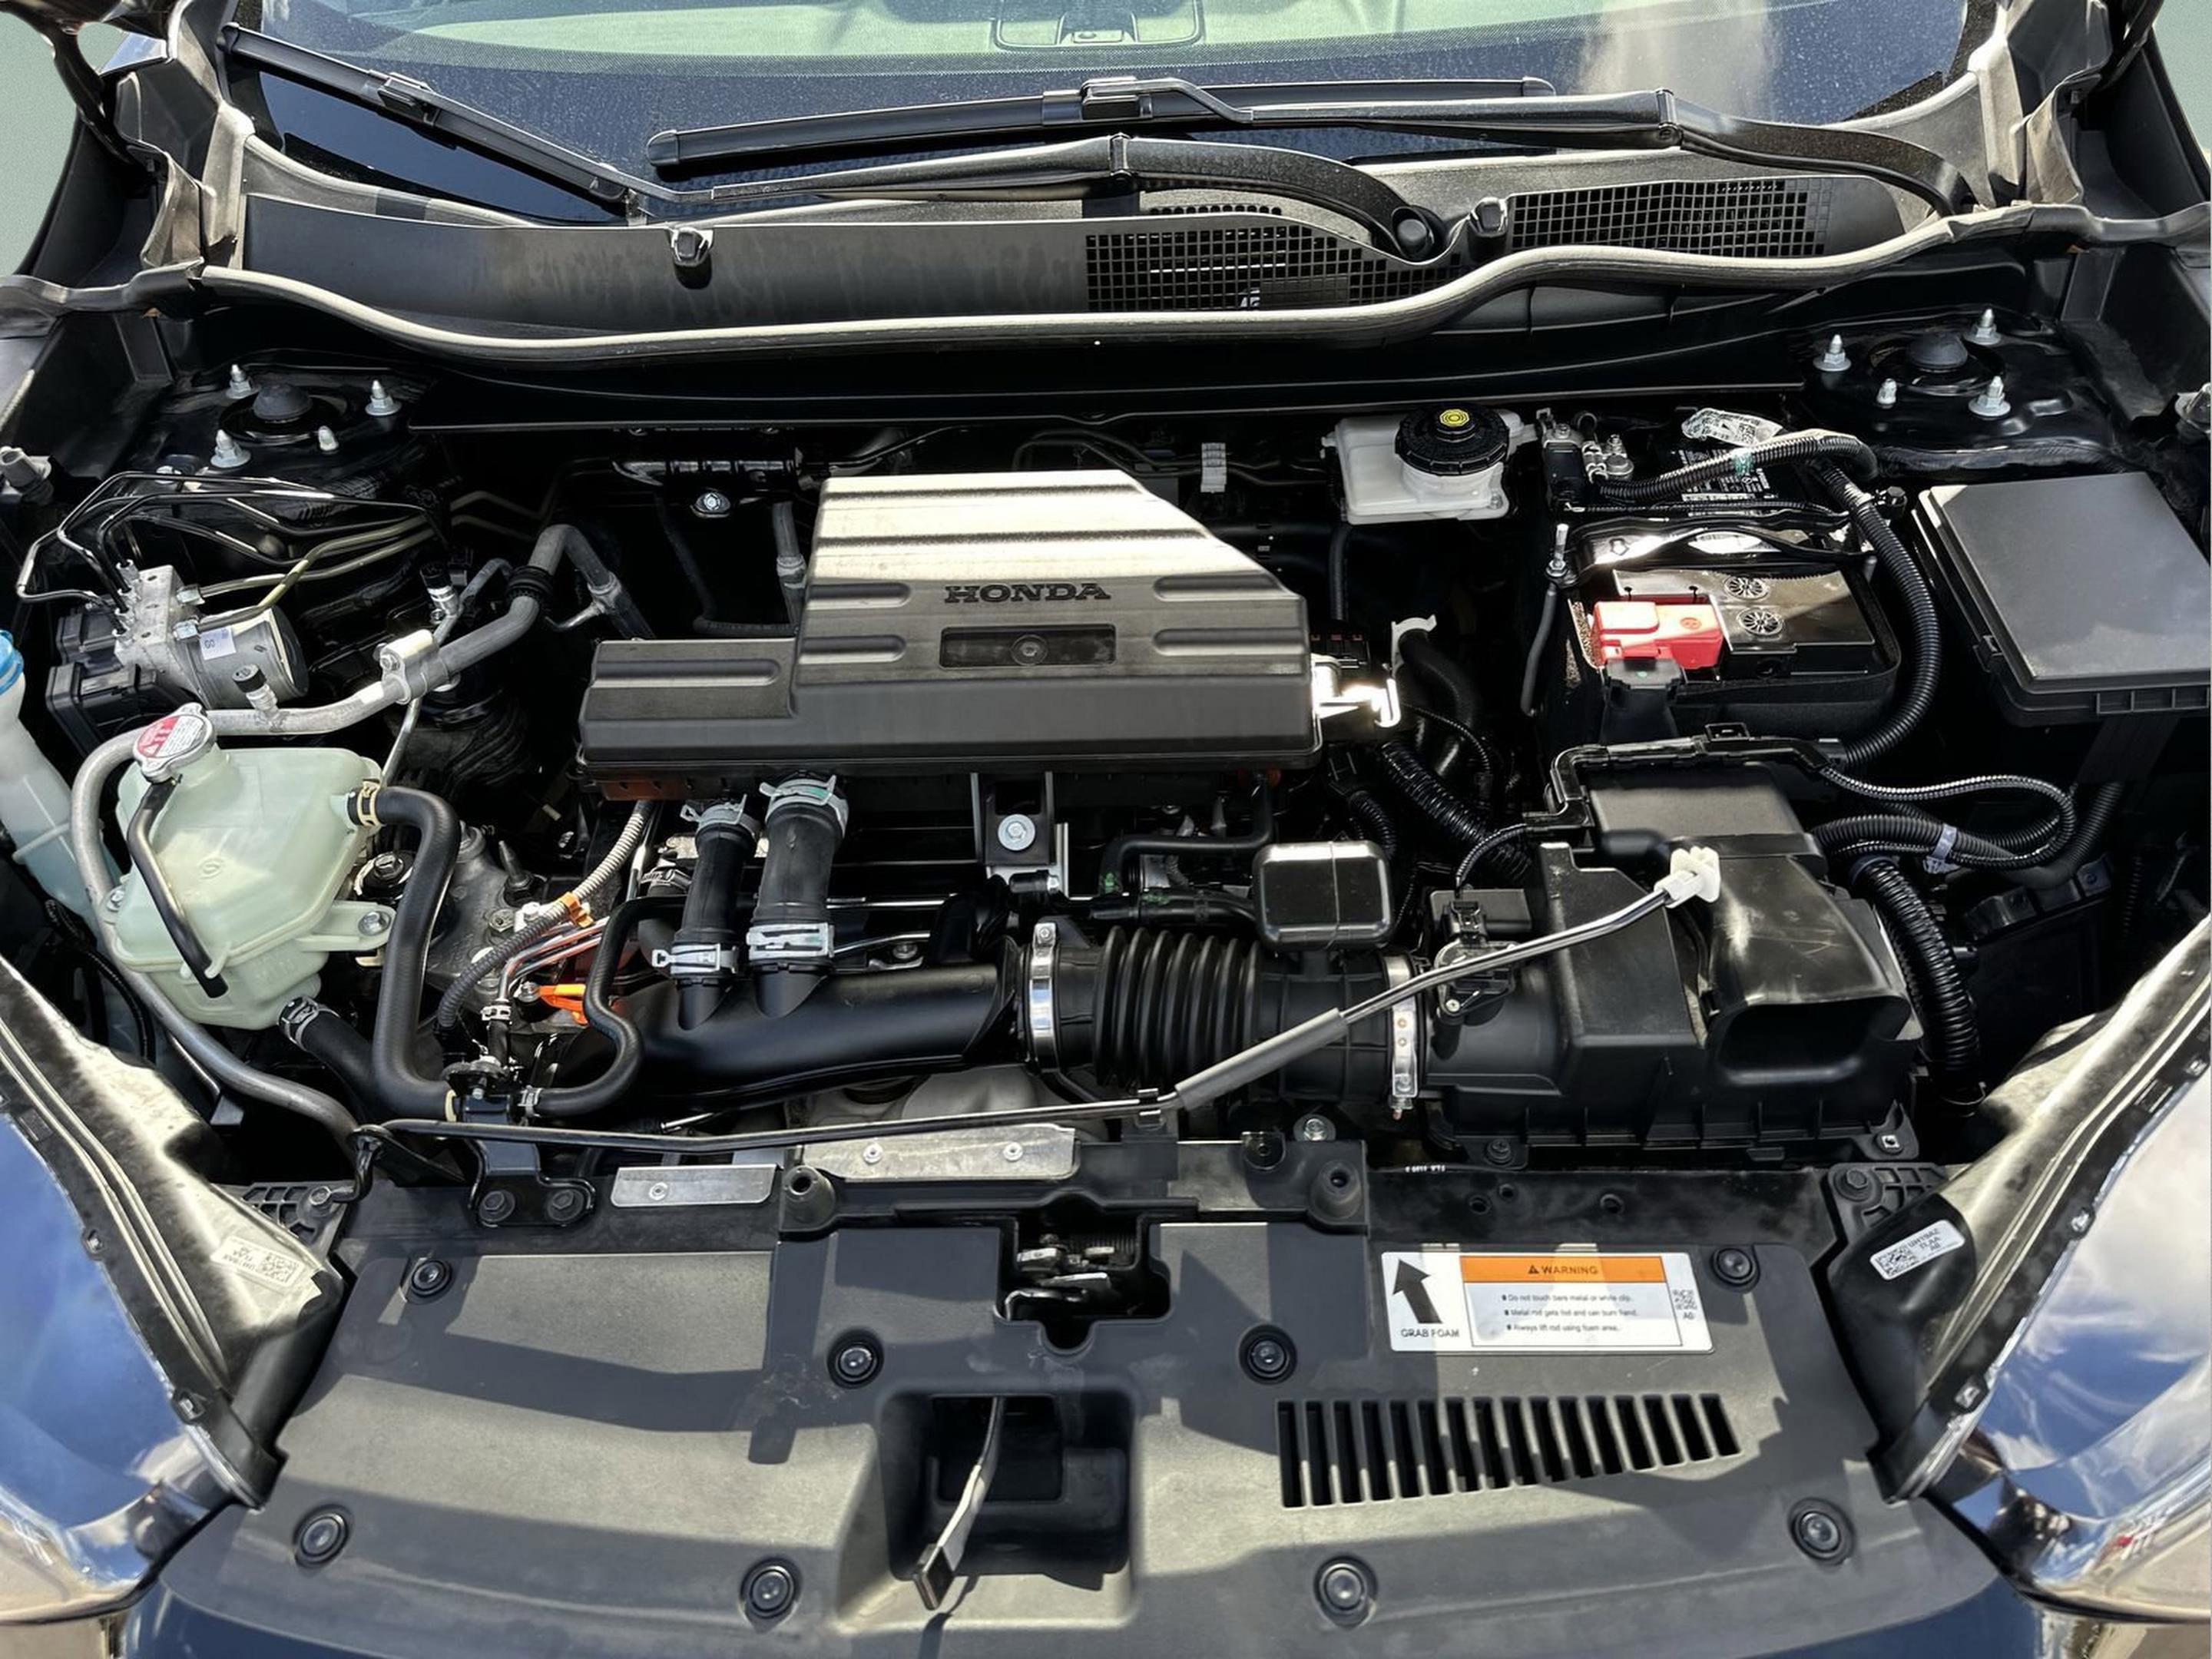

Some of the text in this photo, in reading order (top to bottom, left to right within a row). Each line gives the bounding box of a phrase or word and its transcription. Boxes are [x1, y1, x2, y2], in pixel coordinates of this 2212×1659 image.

[945, 583, 1111, 603] HONDA
[1541, 1265, 1598, 1275] WARNING
[1508, 1293, 1518, 1302] Do
[1532, 1293, 1551, 1302] touch
[1570, 1293, 1588, 1302] metal
[1400, 1329, 1459, 1337] GRAB FOAM
[1562, 1324, 1581, 1333] using
